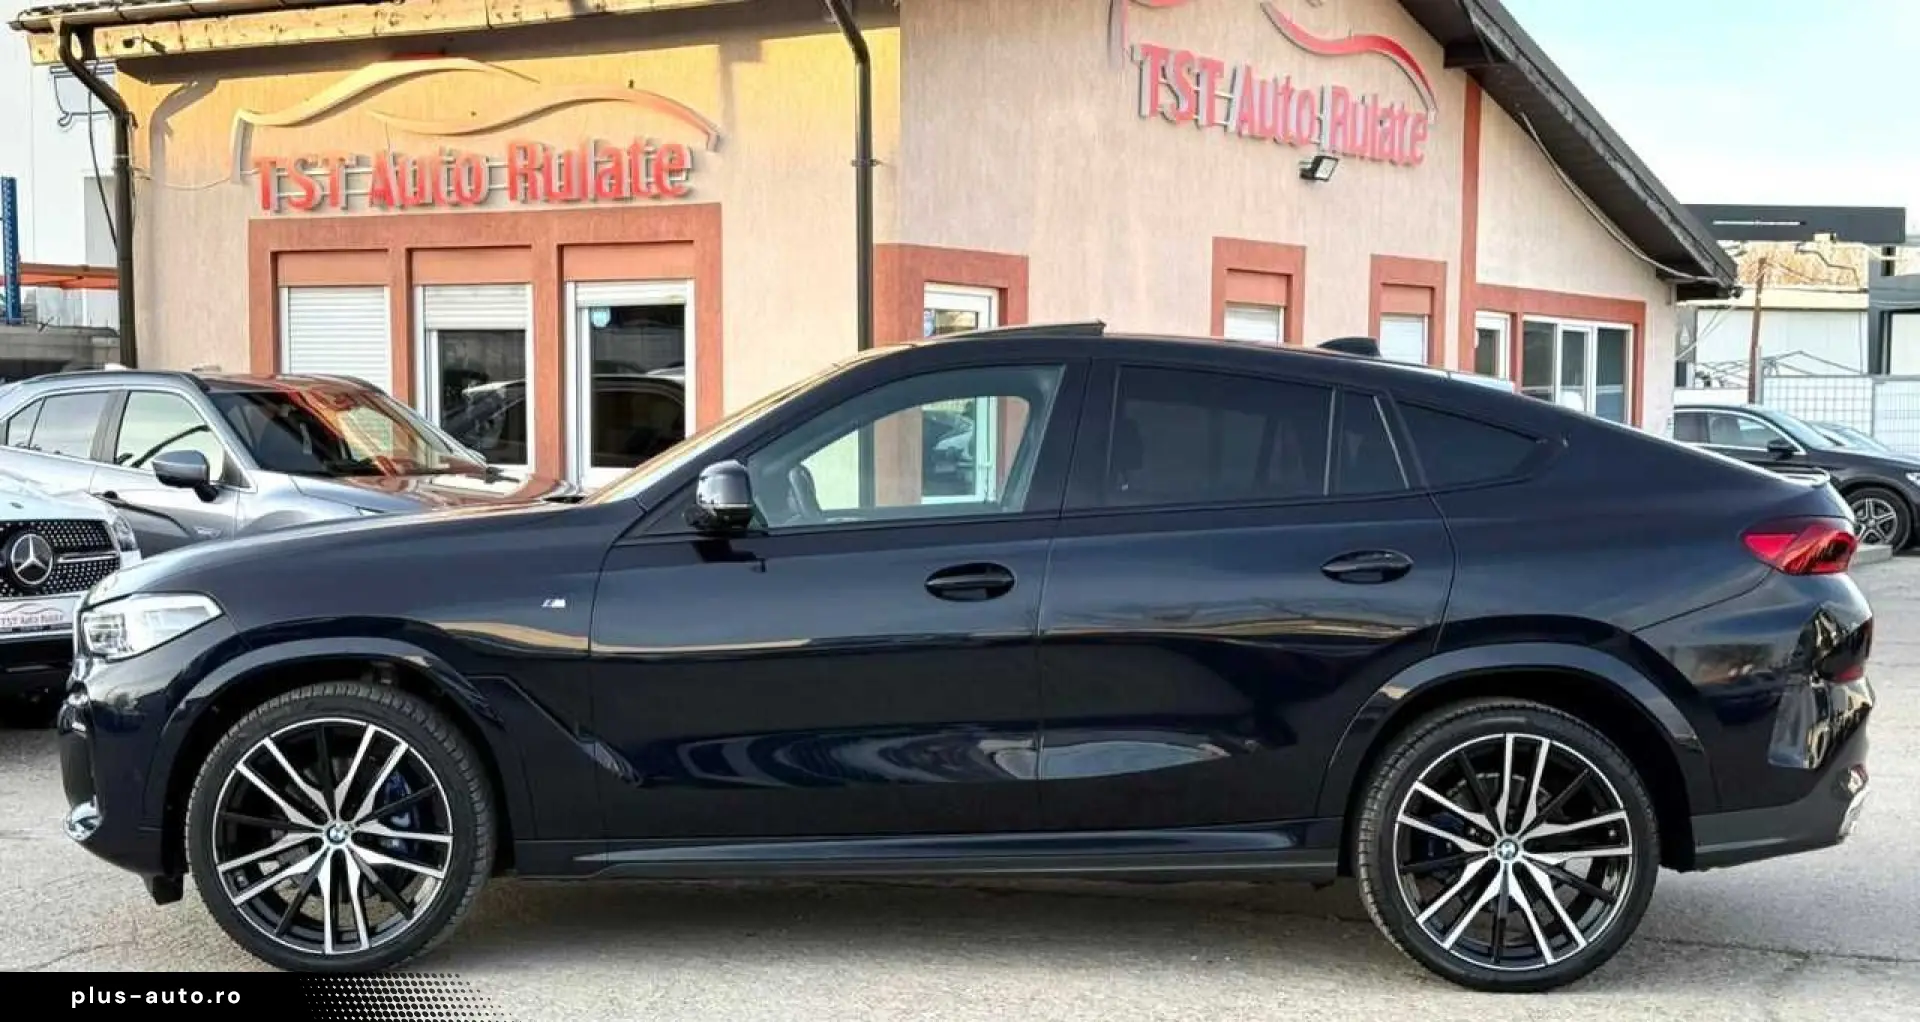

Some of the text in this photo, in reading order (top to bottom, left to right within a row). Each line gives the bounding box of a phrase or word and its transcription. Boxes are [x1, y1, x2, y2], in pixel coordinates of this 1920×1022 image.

[1133, 43, 1428, 166] TST Auto Rulate
[254, 138, 690, 211] TST Auto Rulate
